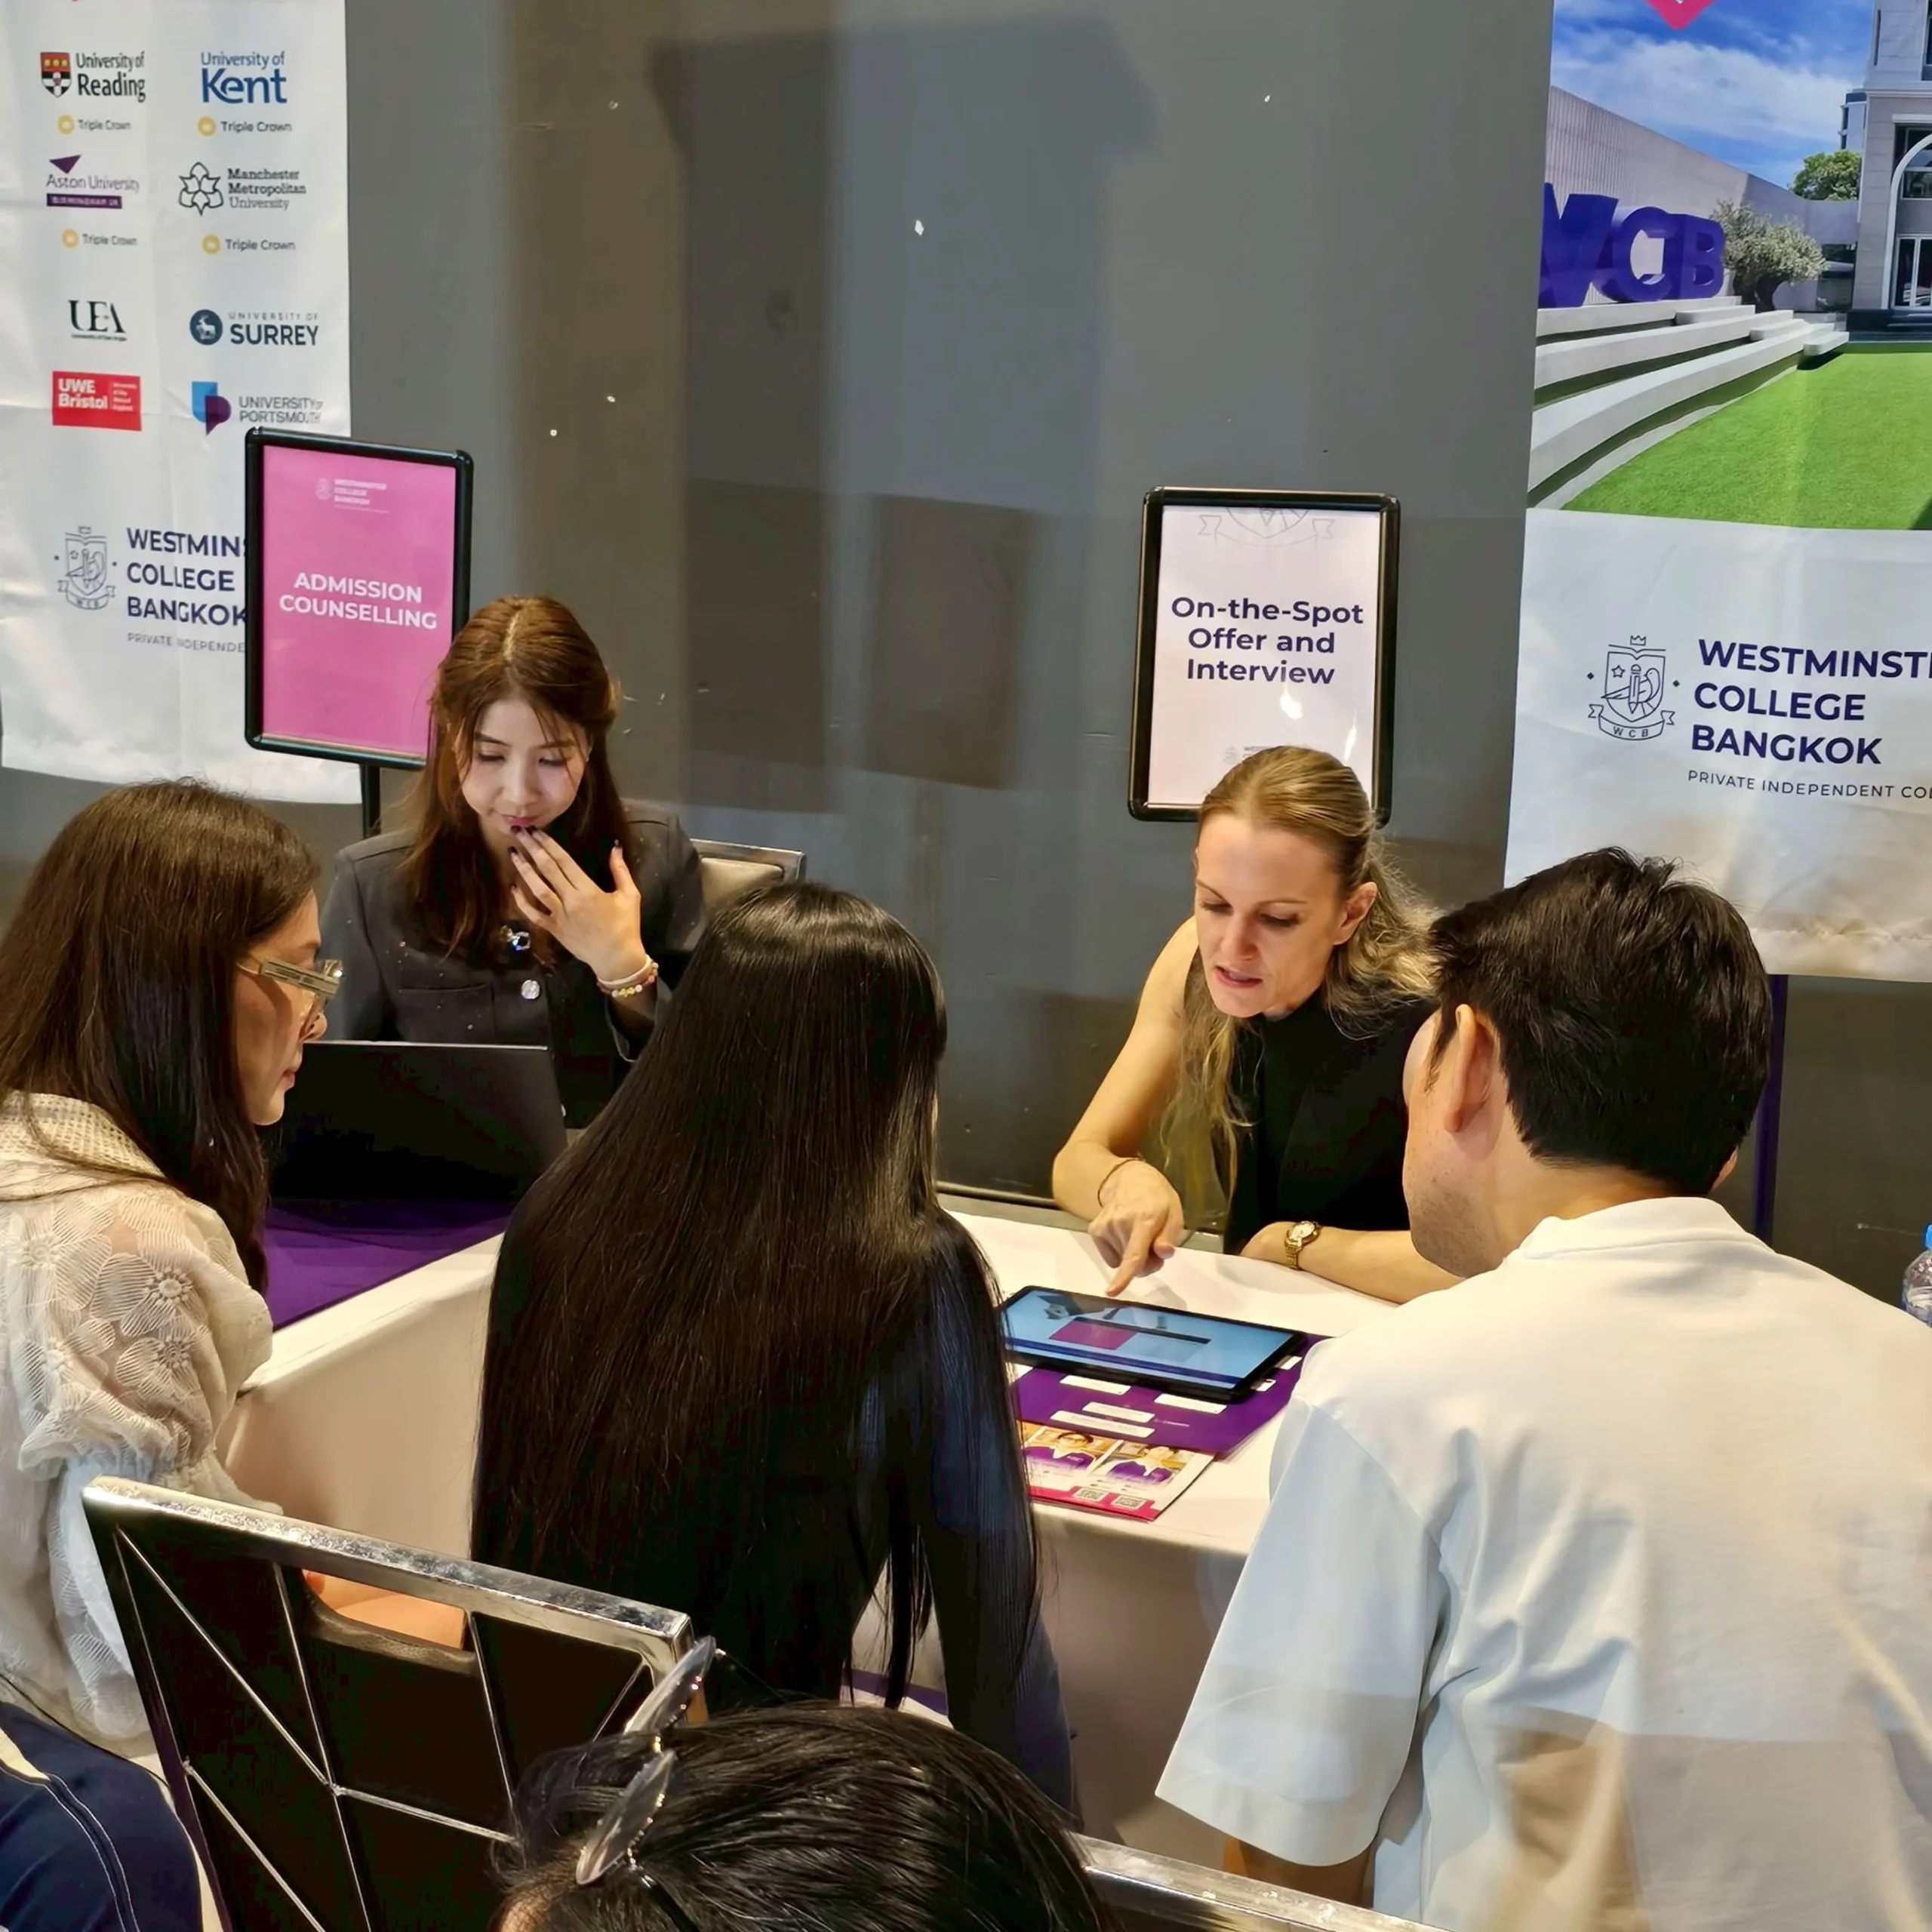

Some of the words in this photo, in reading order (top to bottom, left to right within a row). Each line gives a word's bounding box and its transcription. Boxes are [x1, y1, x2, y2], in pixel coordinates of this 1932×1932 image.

[75, 52, 133, 72] University
[135, 51, 145, 68] of
[201, 51, 269, 70] University
[272, 51, 285, 66] of
[77, 72, 146, 103] Reading
[202, 68, 288, 104] Kent
[220, 121, 254, 134] Triple
[257, 121, 293, 132] Crown
[46, 174, 87, 189] Aston
[88, 175, 140, 195] University
[227, 168, 300, 180] Manchester
[228, 182, 306, 197] Metropolitan
[229, 196, 290, 211] University
[225, 238, 259, 252] Triple
[260, 239, 296, 251] Crown
[69, 300, 127, 334] UEA
[228, 312, 301, 321] UNIVERSITY
[306, 312, 318, 321] OF
[229, 323, 319, 346] SURREY
[58, 378, 96, 394] UWE
[58, 393, 108, 410] Bristol
[238, 395, 315, 410] UNIVERSITY
[239, 410, 322, 424] PORTSMOTH
[126, 527, 246, 558] WESTMIN
[126, 561, 235, 592] COLLEGE
[294, 571, 423, 604] ADMISSION
[127, 595, 247, 626] BANGKOK
[278, 593, 438, 630] COUNSELLING
[1171, 596, 1364, 628] On-the-Spot
[127, 631, 173, 647] PRIVATE
[177, 638, 245, 654] DEPENDE
[1188, 627, 1268, 649] Offer
[1276, 632, 1336, 654] and
[1698, 638, 1932, 679] WESTMINST
[1186, 658, 1336, 685] Interview
[1694, 681, 1867, 721] COLLEGE
[1691, 724, 1884, 765] BANGKOK
[1687, 770, 1755, 790] PRIVATE
[1761, 780, 1894, 798] INDEPENDENT
